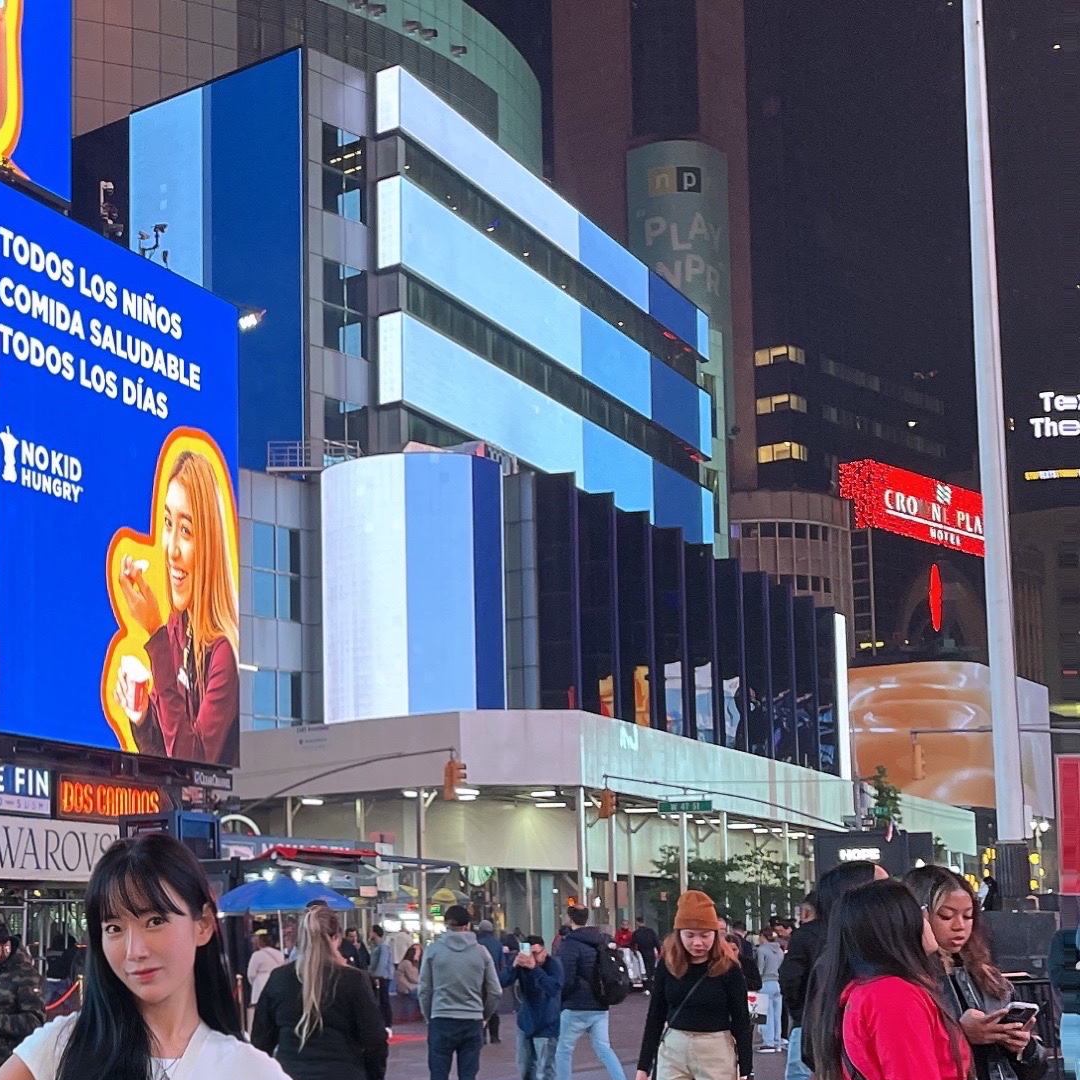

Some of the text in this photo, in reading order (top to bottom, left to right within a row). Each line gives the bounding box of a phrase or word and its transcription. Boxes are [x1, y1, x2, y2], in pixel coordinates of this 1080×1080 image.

[79, 267, 118, 309] LOS
[122, 288, 183, 340] NIÑOS
[89, 318, 200, 391] SALUDABLE
[79, 358, 118, 399] LOS
[122, 377, 168, 419] DÍAS
[21, 439, 82, 482] NO KID
[21, 467, 82, 503] HUNGRY
[884, 489, 949, 525] CRON
[930, 527, 961, 546] HOTEL
[15, 763, 49, 797] FIN
[61, 781, 93, 814] DOS
